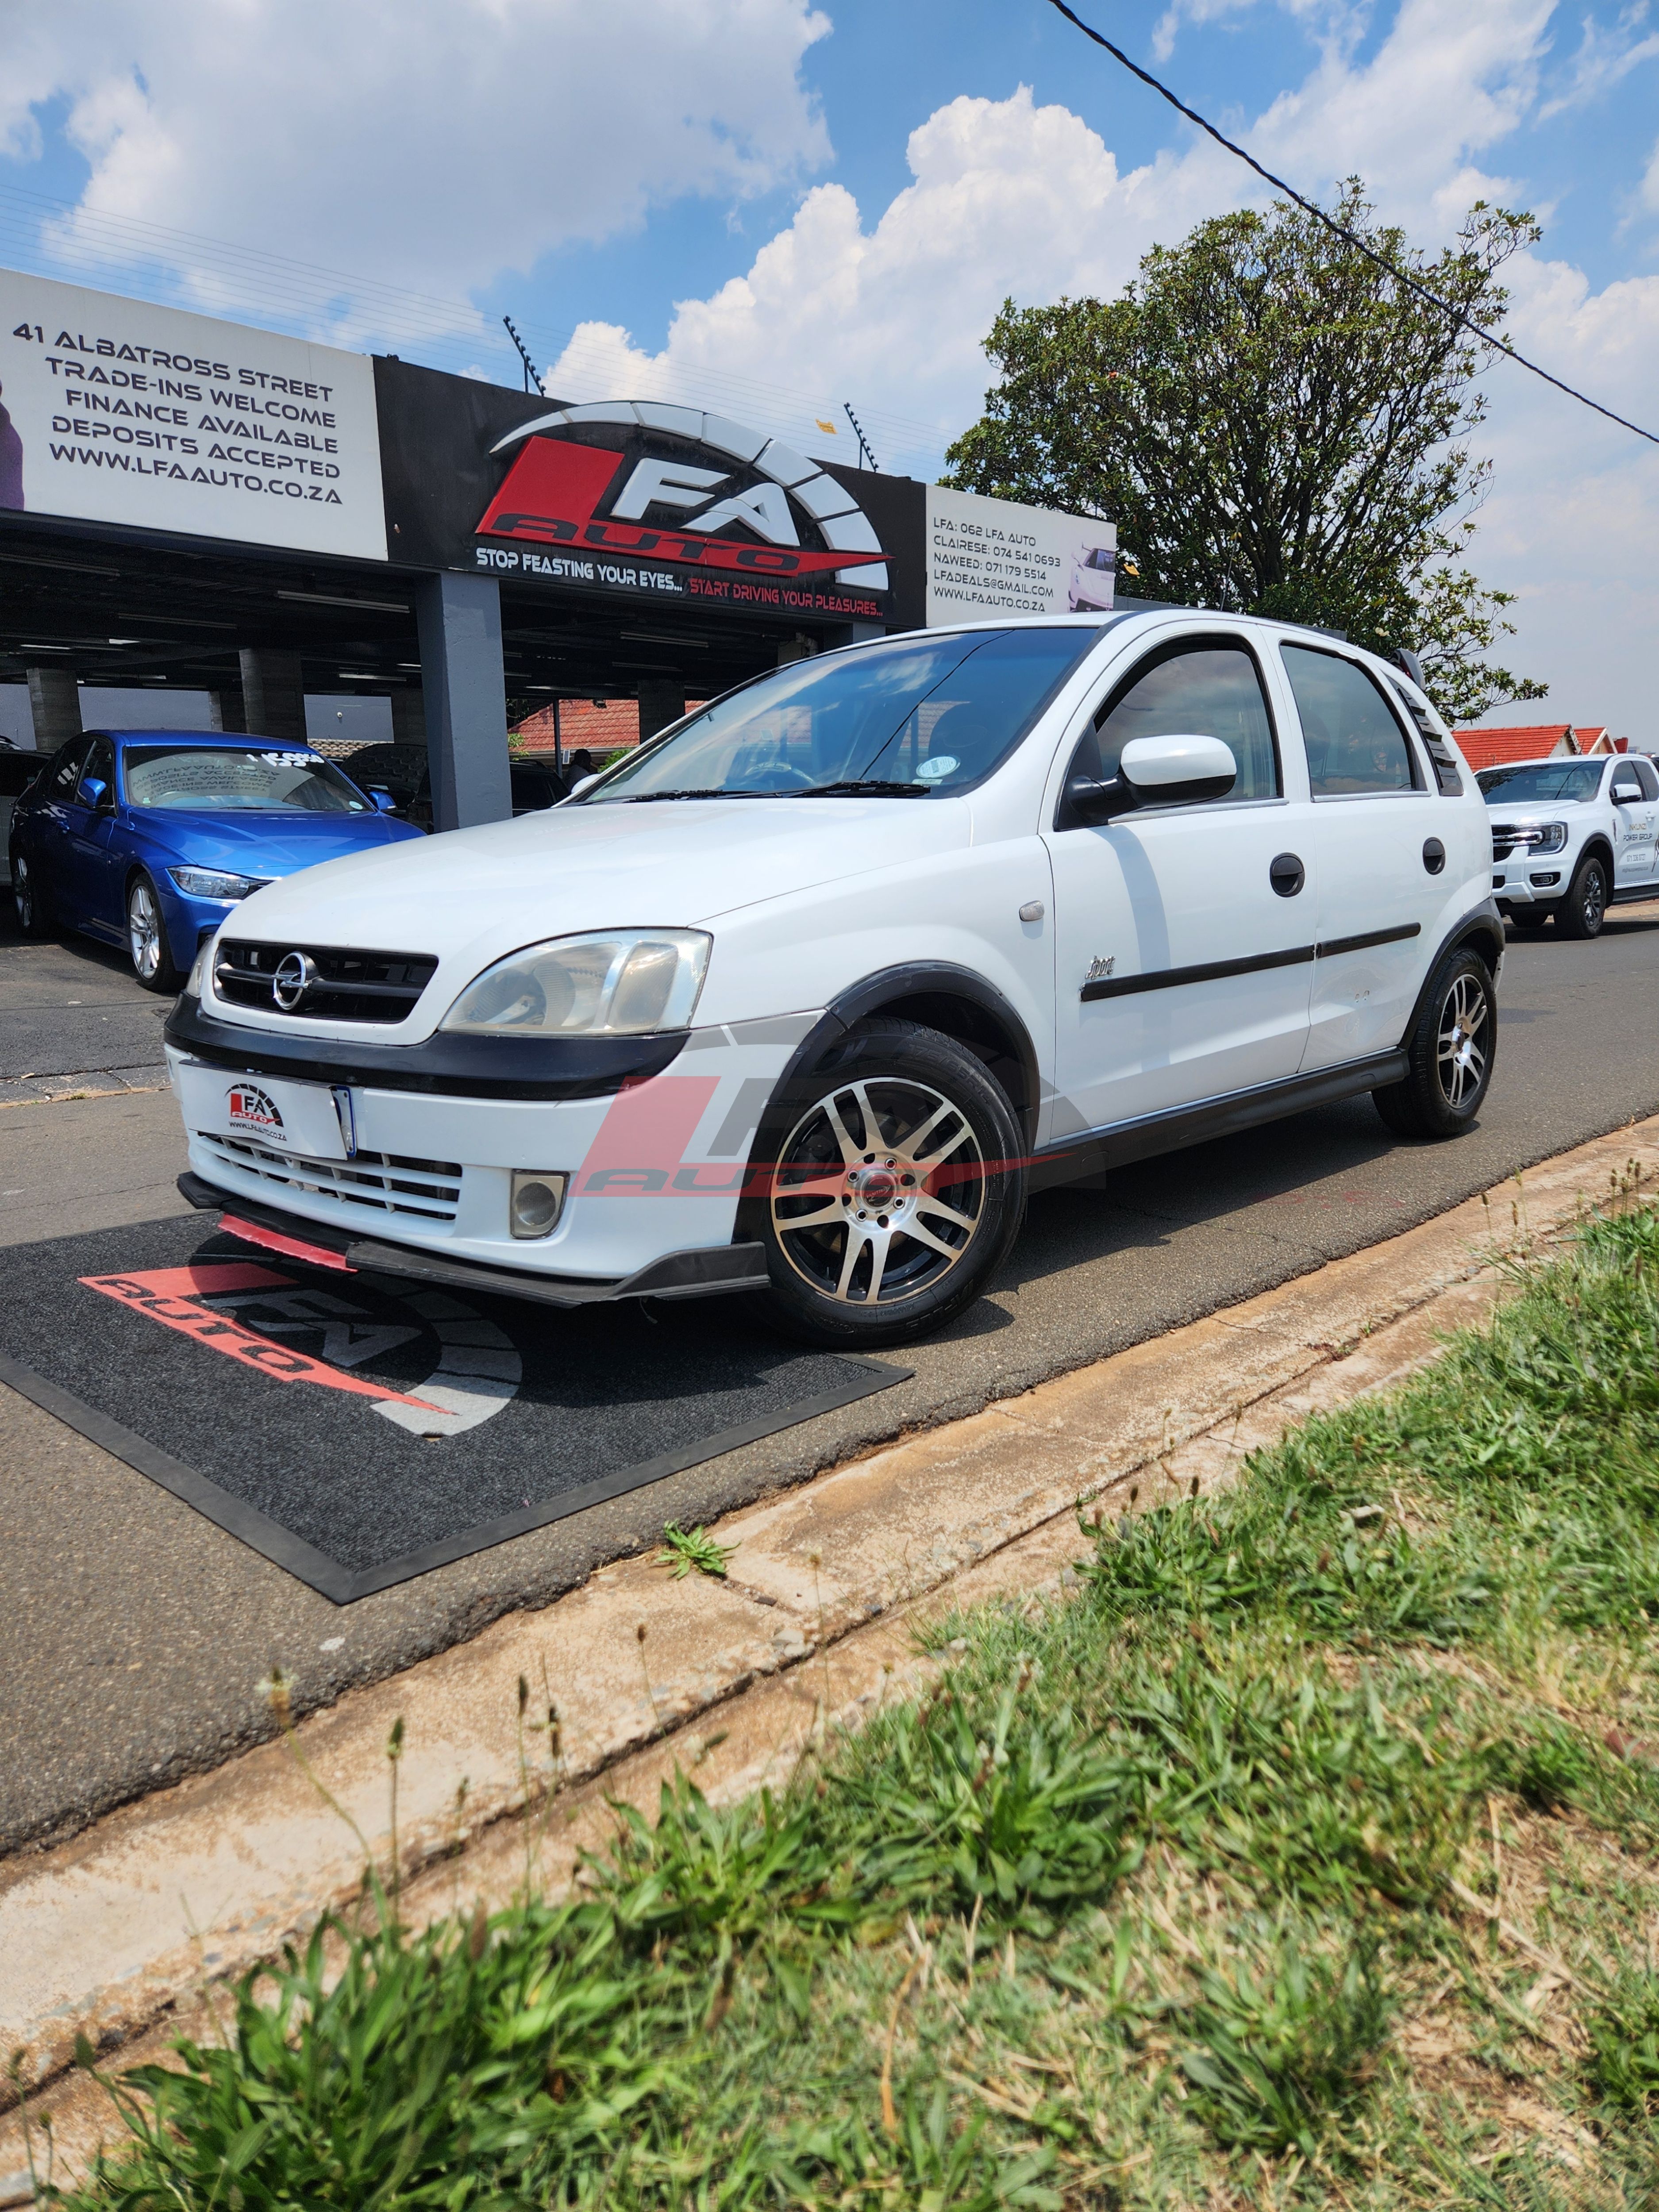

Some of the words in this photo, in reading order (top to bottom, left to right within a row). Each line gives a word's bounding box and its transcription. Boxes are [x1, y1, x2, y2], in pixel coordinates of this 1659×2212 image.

[12, 323, 44, 343] 41
[54, 331, 231, 381] ALBATROSS
[238, 369, 334, 402] STREET
[45, 357, 203, 402] TRADE-INS
[209, 389, 336, 429] WELCOME
[65, 389, 189, 427] FINANCE
[197, 415, 339, 454] AVAILABLE
[49, 443, 343, 505] WWW.LFAAUTO.CO.ZA
[52, 415, 199, 455] DEPOSITS
[207, 443, 340, 479] ACCEPTED
[491, 513, 800, 571] AUTO
[933, 517, 957, 532] LFA:
[960, 523, 982, 537] 062
[985, 527, 1005, 541] LFA
[1008, 533, 1036, 547] AUTO
[934, 535, 990, 555] CLAIRESE:
[993, 546, 1012, 559] 074
[1015, 550, 1032, 562] 541
[1034, 554, 1061, 567] 0693
[476, 547, 519, 569] STOP
[523, 554, 594, 580] FEASTING
[597, 564, 636, 585] YOUR
[639, 571, 682, 592] EYES...
[689, 578, 730, 597] START
[733, 584, 779, 604] DRIVING
[782, 590, 813, 608] YOUR
[816, 595, 883, 617] PLEASURES...
[934, 552, 982, 570] NAWEED:
[985, 561, 1002, 573] 071
[1005, 565, 1021, 577] 179
[1024, 568, 1047, 581] 5514
[934, 569, 1054, 598] LFADEALS@GMAIL.COM
[934, 586, 1045, 612] WWW.LFAAUTO.CO.ZA
[232, 1112, 267, 1123] AUTO
[95, 1278, 314, 1372] AUTO
